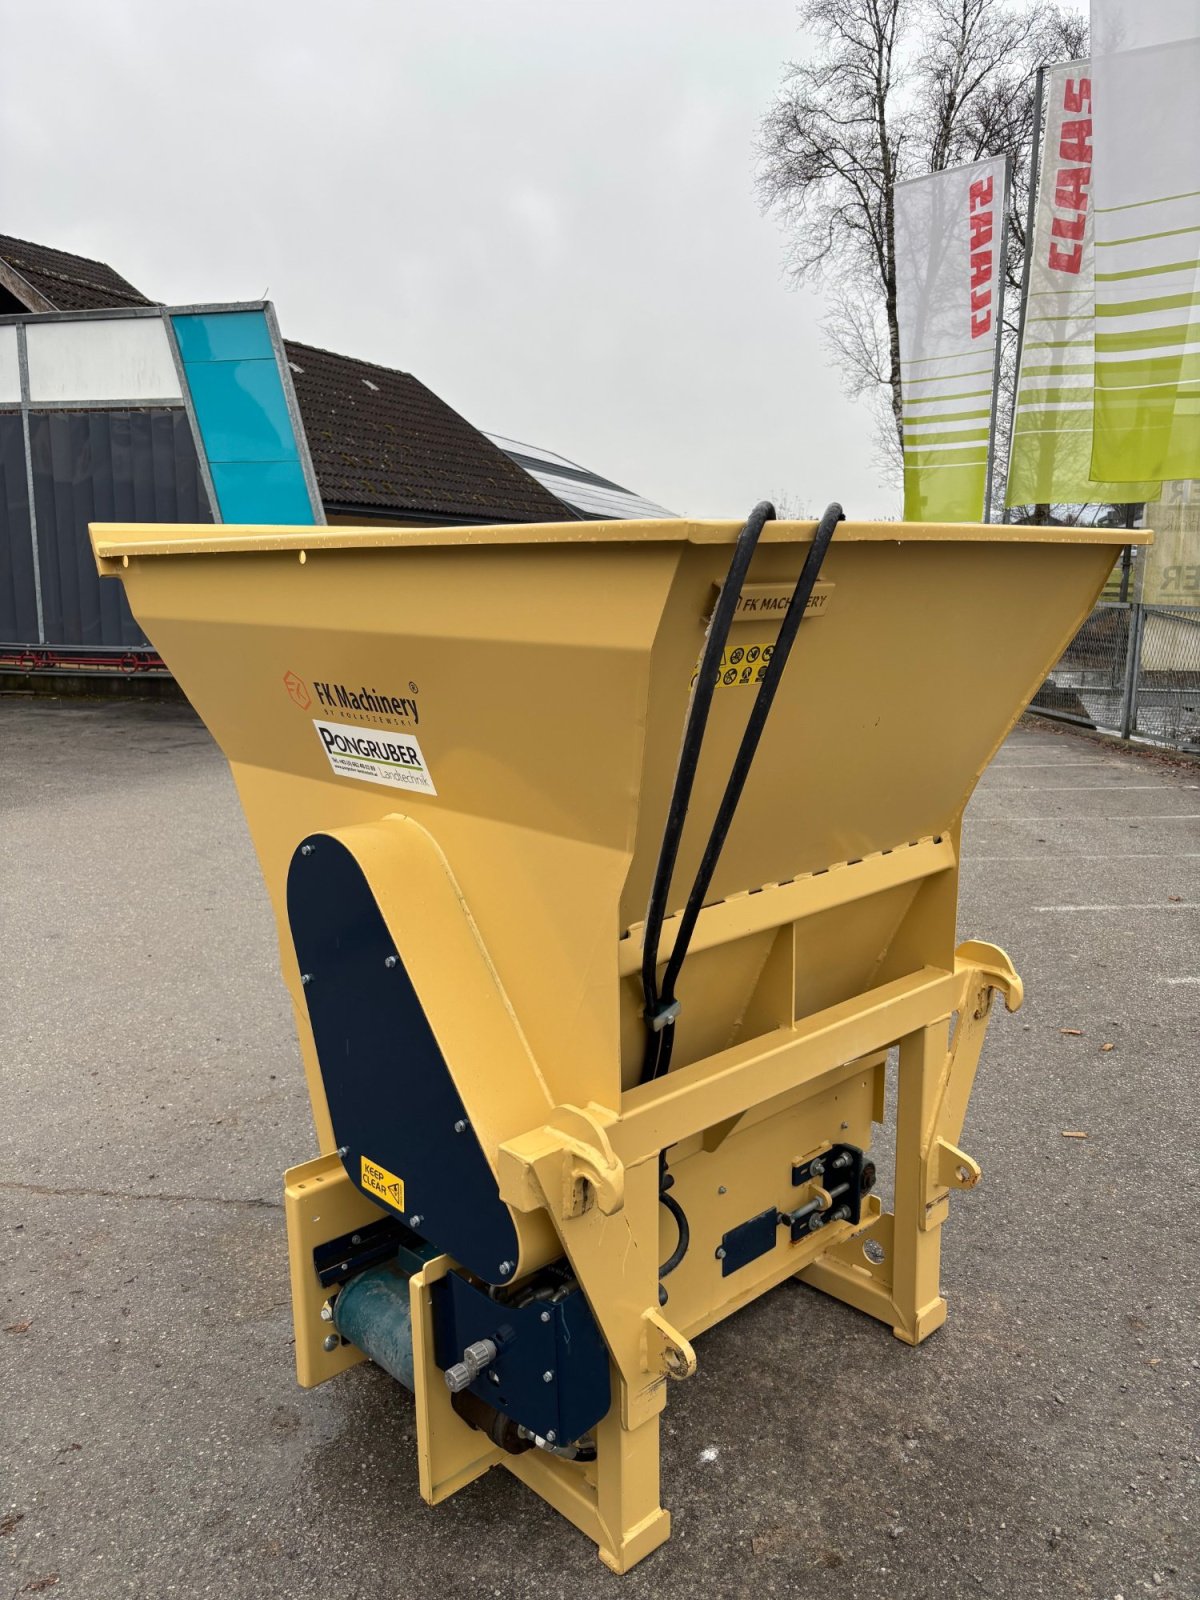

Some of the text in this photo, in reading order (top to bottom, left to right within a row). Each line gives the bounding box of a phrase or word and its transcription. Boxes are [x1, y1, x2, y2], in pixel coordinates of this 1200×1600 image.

[1048, 78, 1093, 275] CLAAS
[743, 595, 827, 611] FK MACHERY
[313, 682, 419, 724] FK Machinery
[318, 727, 421, 766] PONGRUBER
[378, 767, 429, 786] Landtechnik
[365, 1164, 384, 1181] KEEP
[363, 1174, 387, 1195] CLEAR
